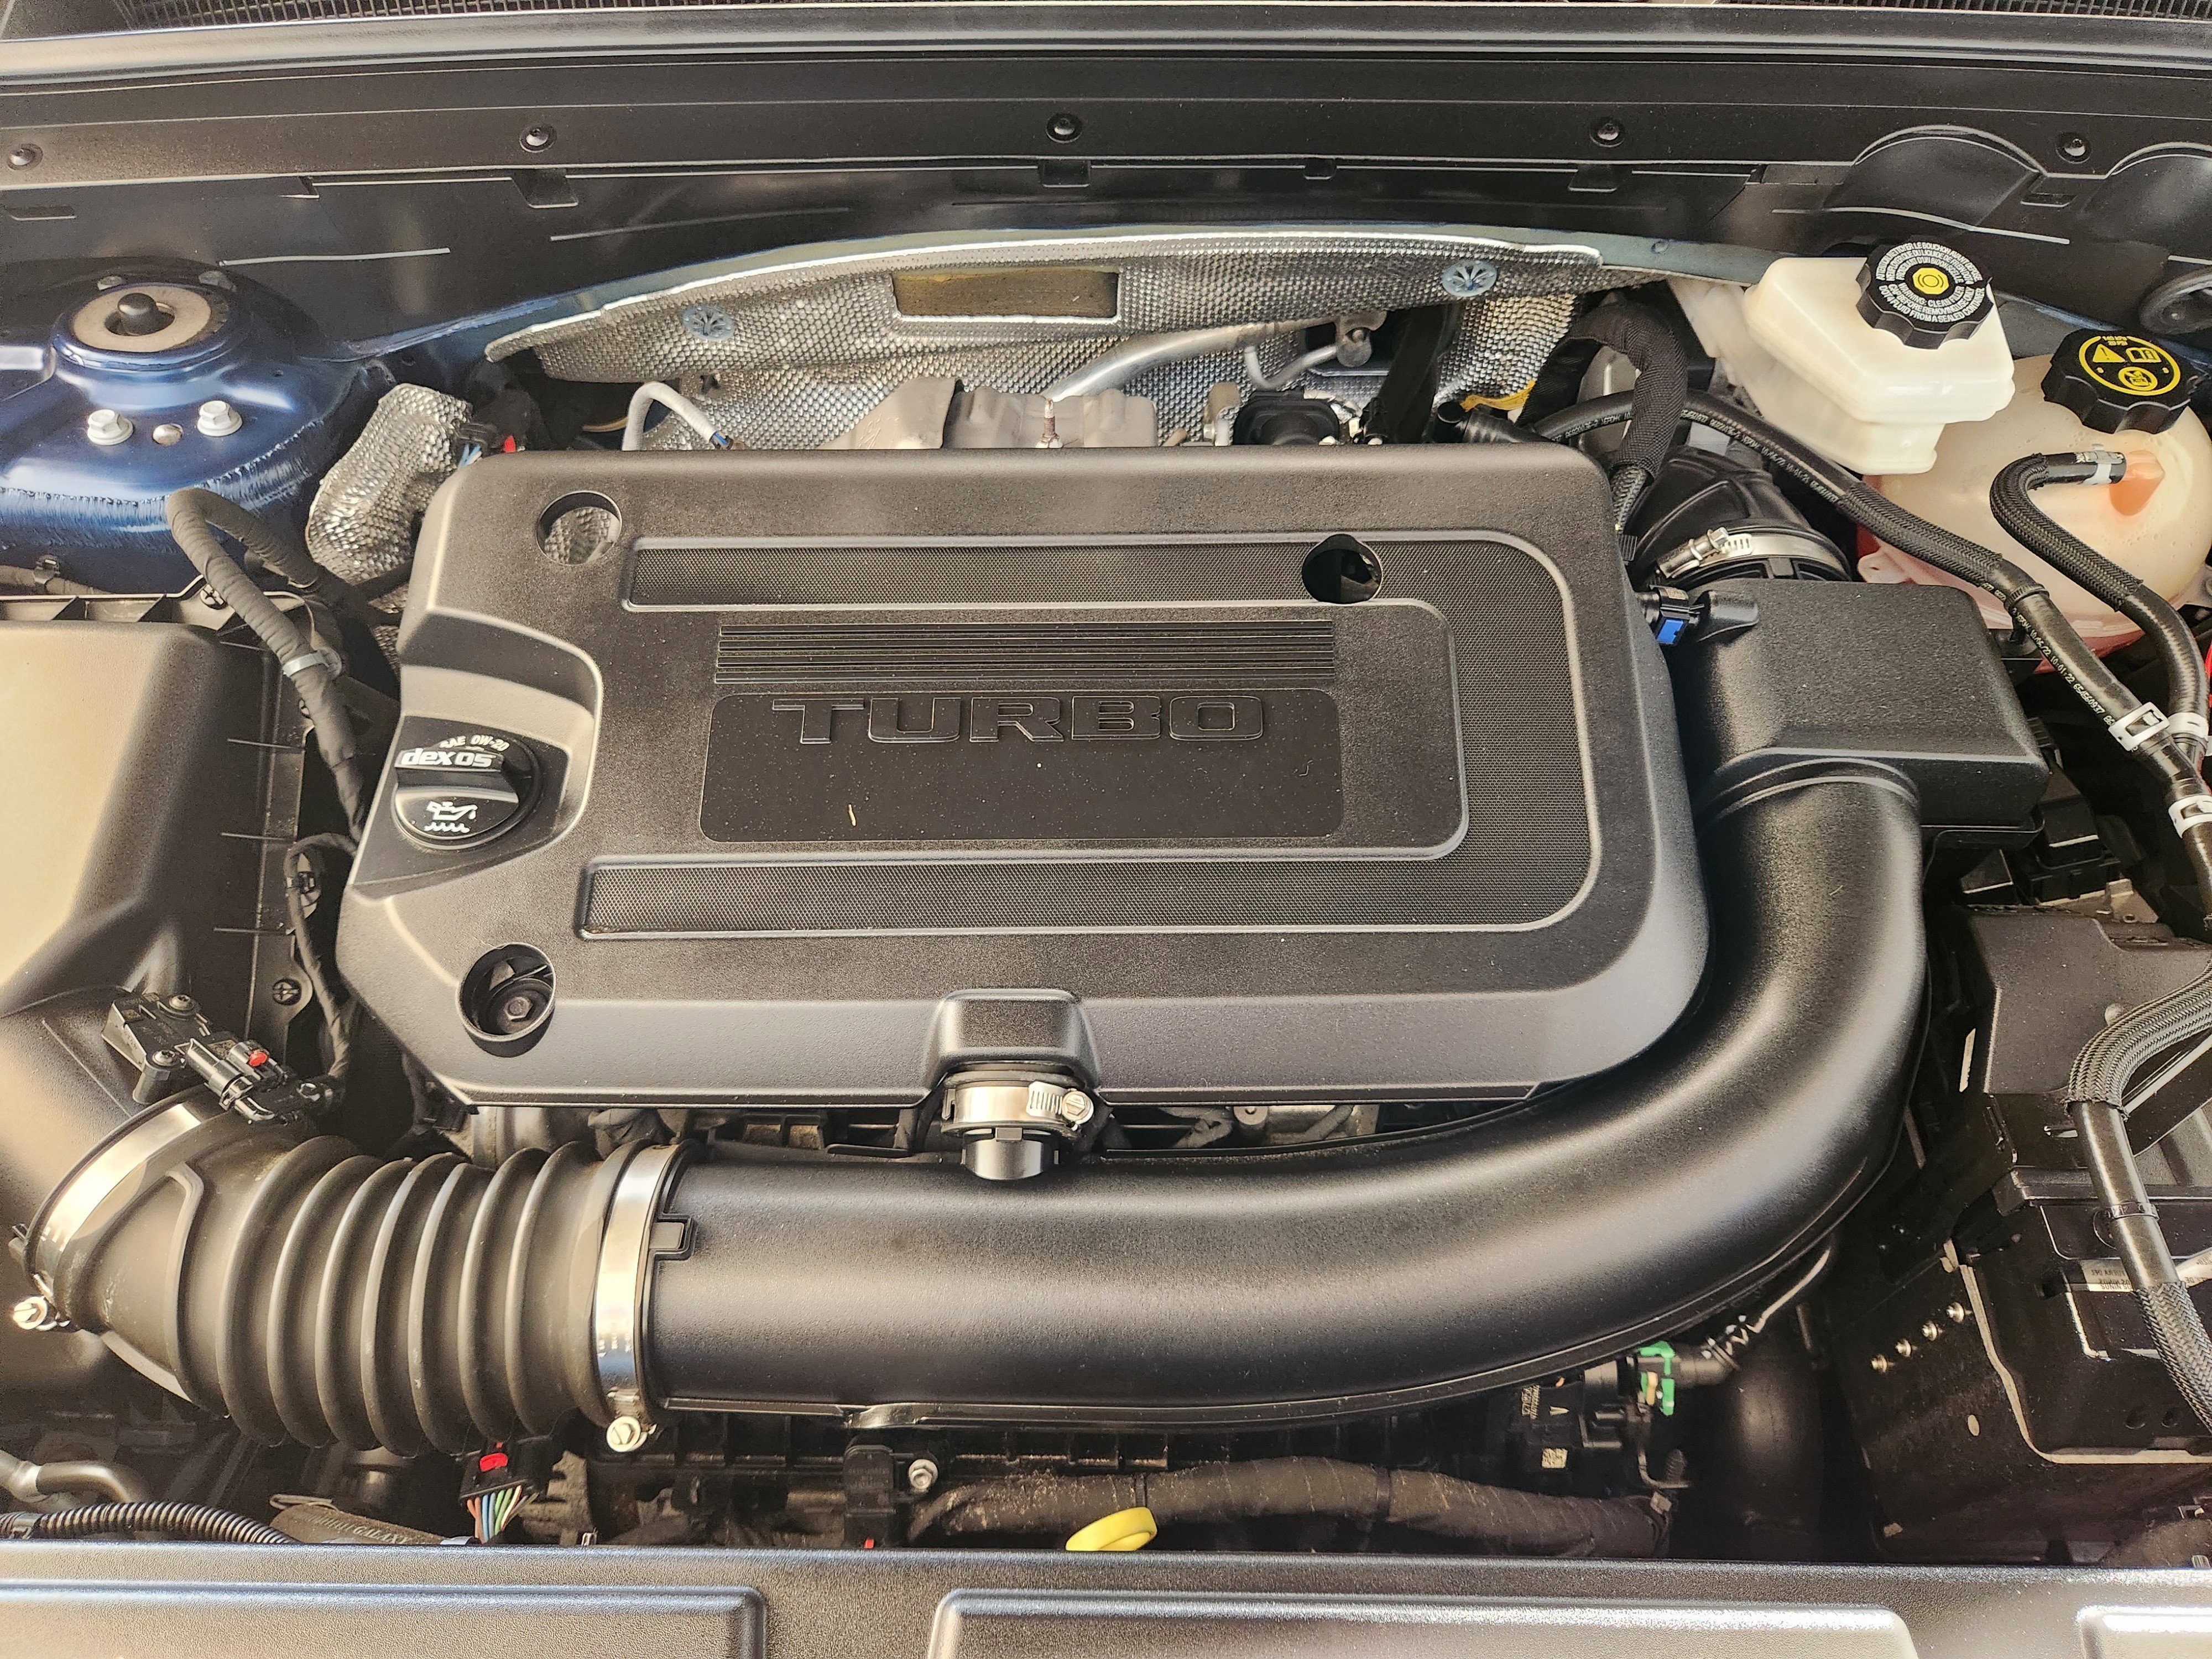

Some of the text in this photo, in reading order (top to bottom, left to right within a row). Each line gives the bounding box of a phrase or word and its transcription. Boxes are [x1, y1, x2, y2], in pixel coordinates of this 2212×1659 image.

[1921, 242, 1952, 254] BOUCHON
[1949, 249, 1970, 265] AVANT
[1921, 249, 1945, 259] LIQUIDE
[1942, 254, 1953, 263] DE
[1949, 258, 1968, 273] FREIN
[1931, 257, 1949, 269] BIDON
[1887, 284, 1902, 296] CAP
[1895, 294, 1923, 312] BEFORE
[1954, 298, 1969, 310] USE
[1962, 286, 1974, 302] ONLY
[1948, 285, 1964, 304] FILLER
[1888, 299, 1911, 315] FLUID
[1908, 310, 1931, 322] FROM
[1937, 310, 1966, 323] SEALED
[773, 696, 1264, 744] TURBO
[439, 734, 510, 751] SAE 0W-20
[401, 748, 496, 768] dexos
